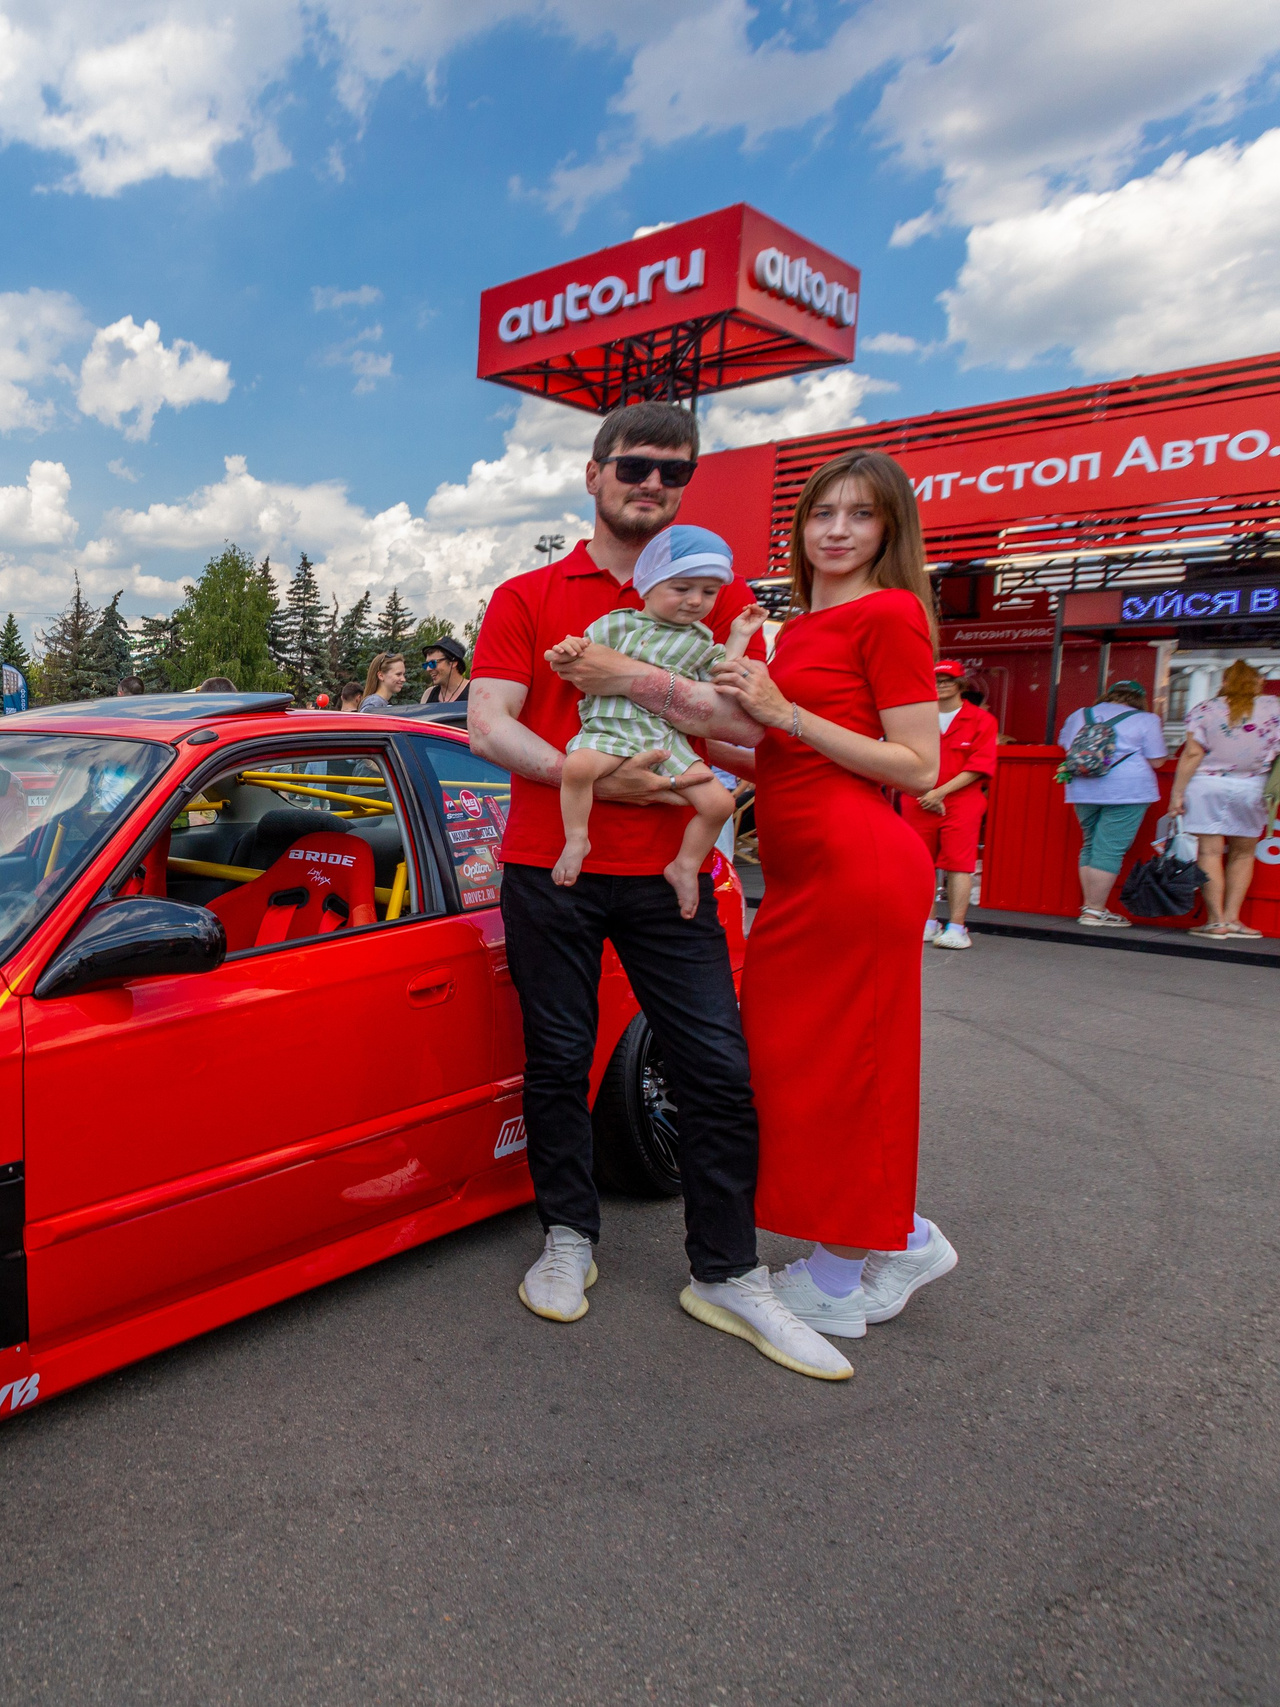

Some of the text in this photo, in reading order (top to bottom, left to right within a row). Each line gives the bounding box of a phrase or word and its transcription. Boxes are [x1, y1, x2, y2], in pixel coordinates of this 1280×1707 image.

[498, 248, 705, 343] auto.ru
[754, 246, 857, 328] auto.ru
[909, 451, 1102, 502] ит-стоп
[954, 626, 1055, 641] Автоэнтузиас
[288, 849, 357, 867] BRIDE
[463, 887, 496, 905] DRIVE2.RU
